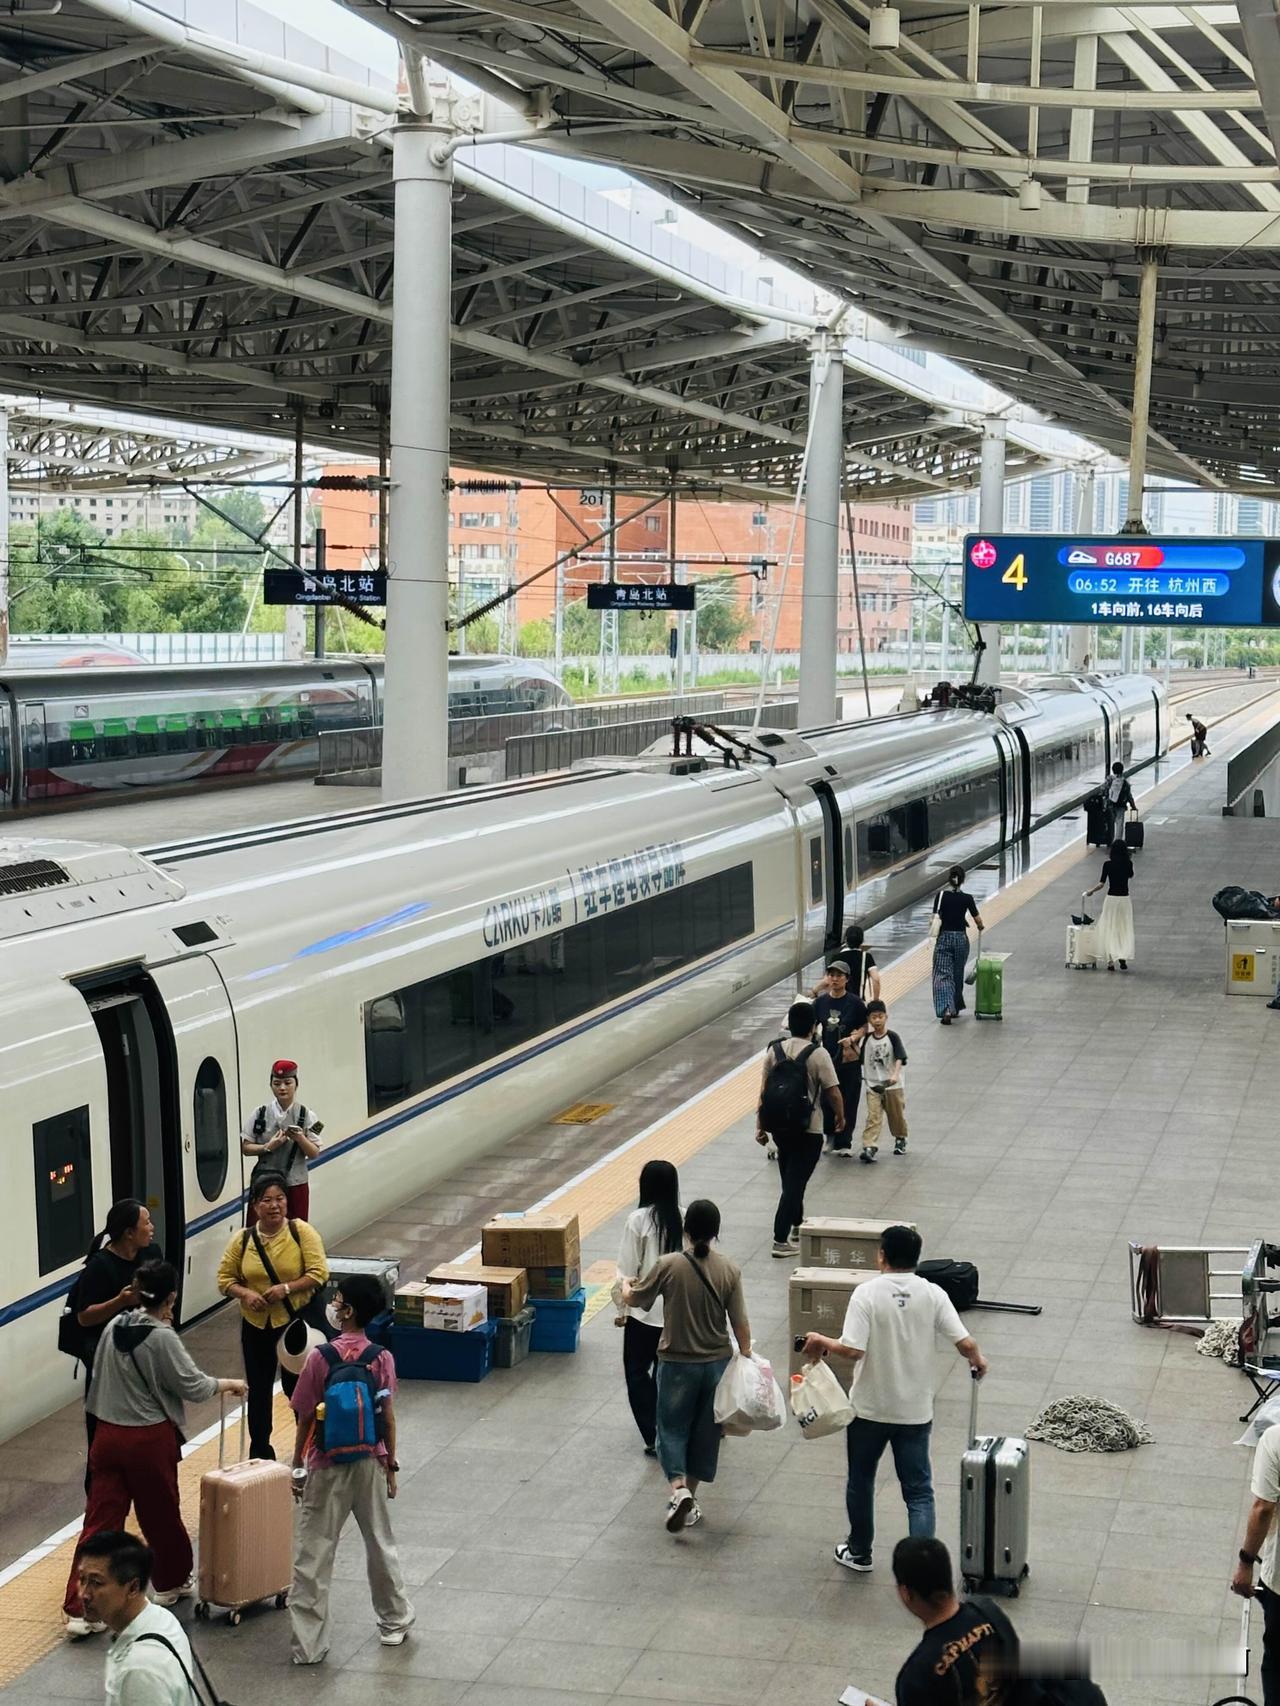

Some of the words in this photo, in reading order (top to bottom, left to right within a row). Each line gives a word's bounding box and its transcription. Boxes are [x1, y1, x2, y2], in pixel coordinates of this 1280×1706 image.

[580, 494, 603, 506] 201
[1105, 552, 1141, 566] G687
[1001, 553, 1028, 591] 4
[1075, 578, 1117, 592] 06:52
[1128, 577, 1160, 593] 开往
[1168, 577, 1217, 593] 杭州西
[615, 587, 667, 601] 青岛北站
[823, 1247, 867, 1265] 振华
